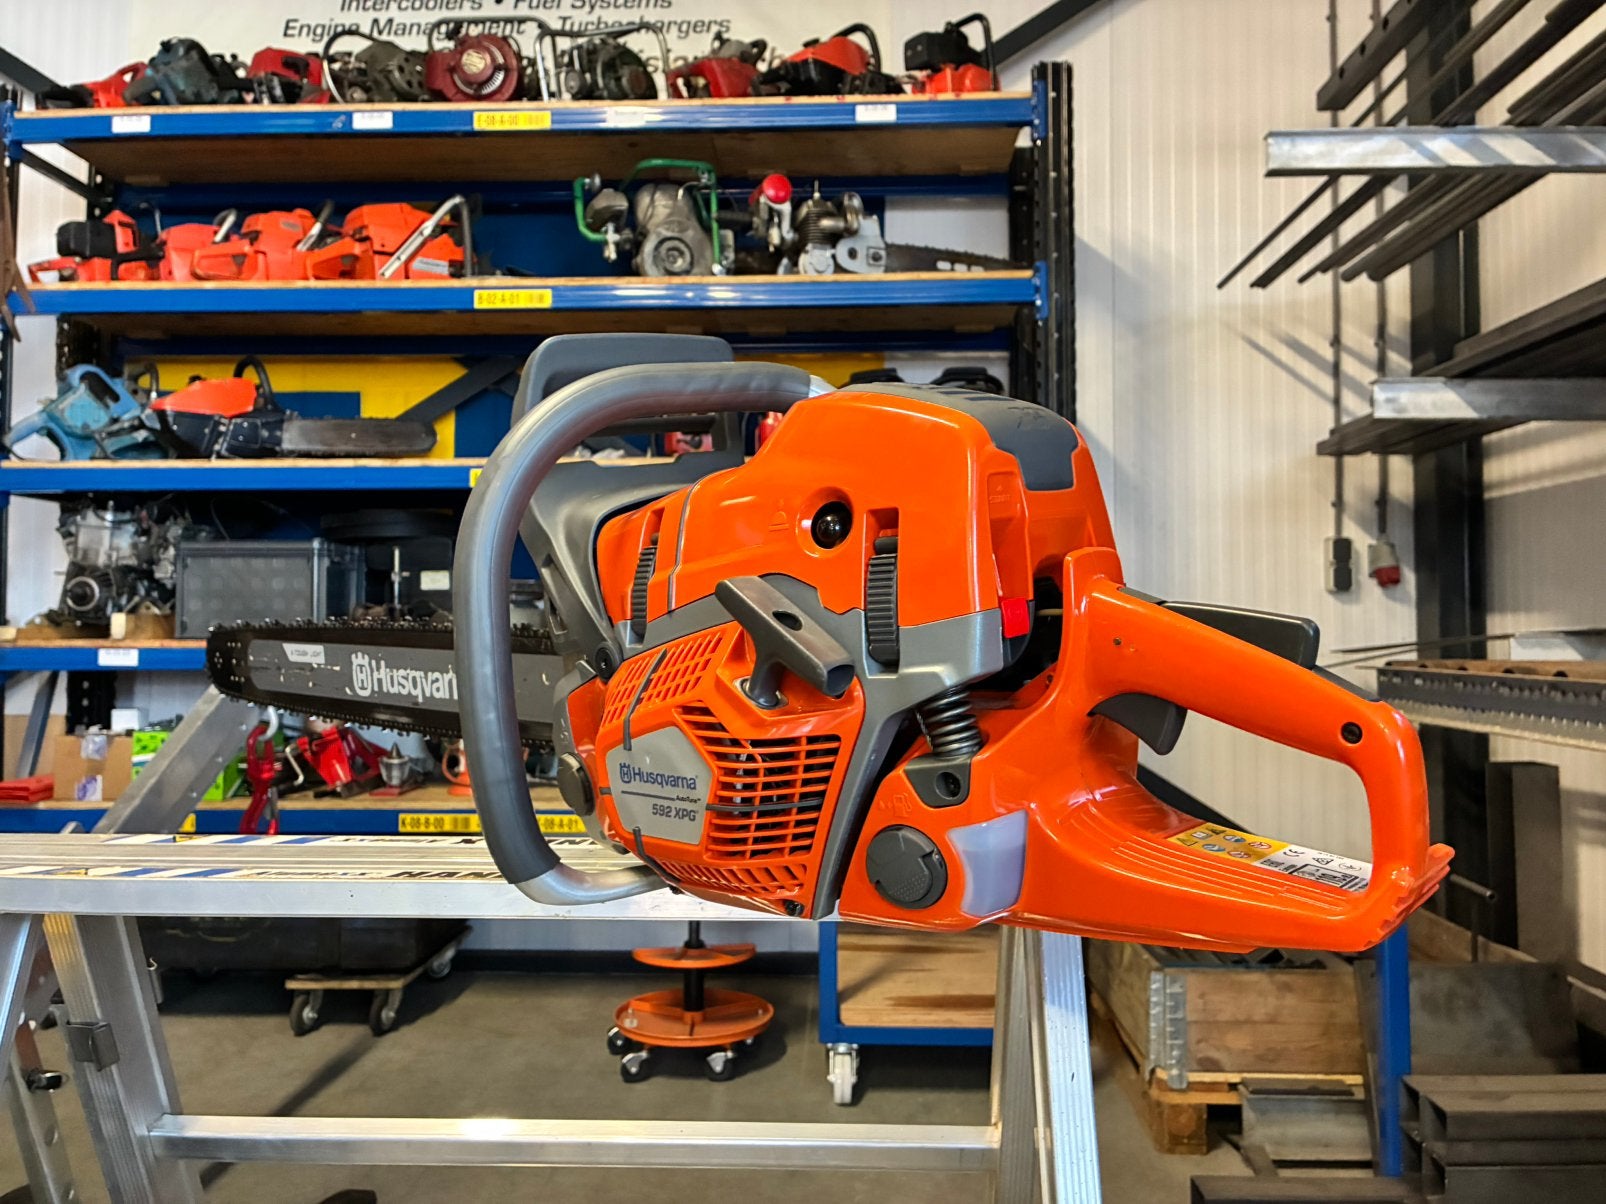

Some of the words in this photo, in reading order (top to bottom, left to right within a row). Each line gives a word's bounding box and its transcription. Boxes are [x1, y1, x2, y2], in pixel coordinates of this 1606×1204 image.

[283, 18, 360, 43] Engine
[369, 18, 526, 42] Managment
[632, 767, 697, 790] Husqvarna
[651, 803, 672, 818] 592
[674, 807, 697, 822] XPG
